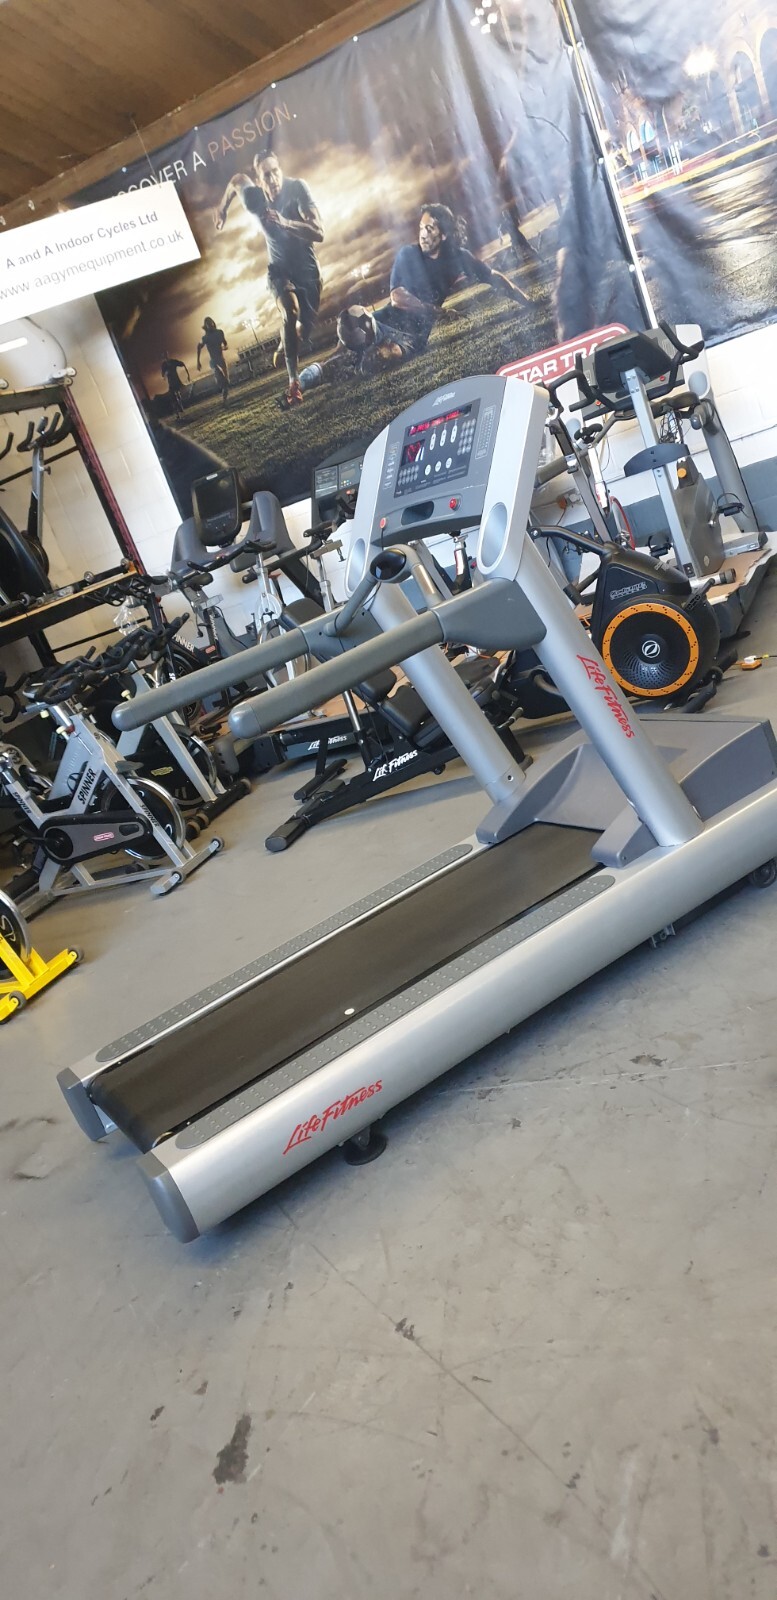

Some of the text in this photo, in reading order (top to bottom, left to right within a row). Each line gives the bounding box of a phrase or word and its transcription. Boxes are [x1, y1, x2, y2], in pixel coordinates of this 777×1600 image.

[192, 151, 207, 172] A
[6, 211, 159, 269] A and A Indoor Cycles Ltd
[560, 335, 616, 368] TRA
[77, 769, 97, 805] SPINNER
